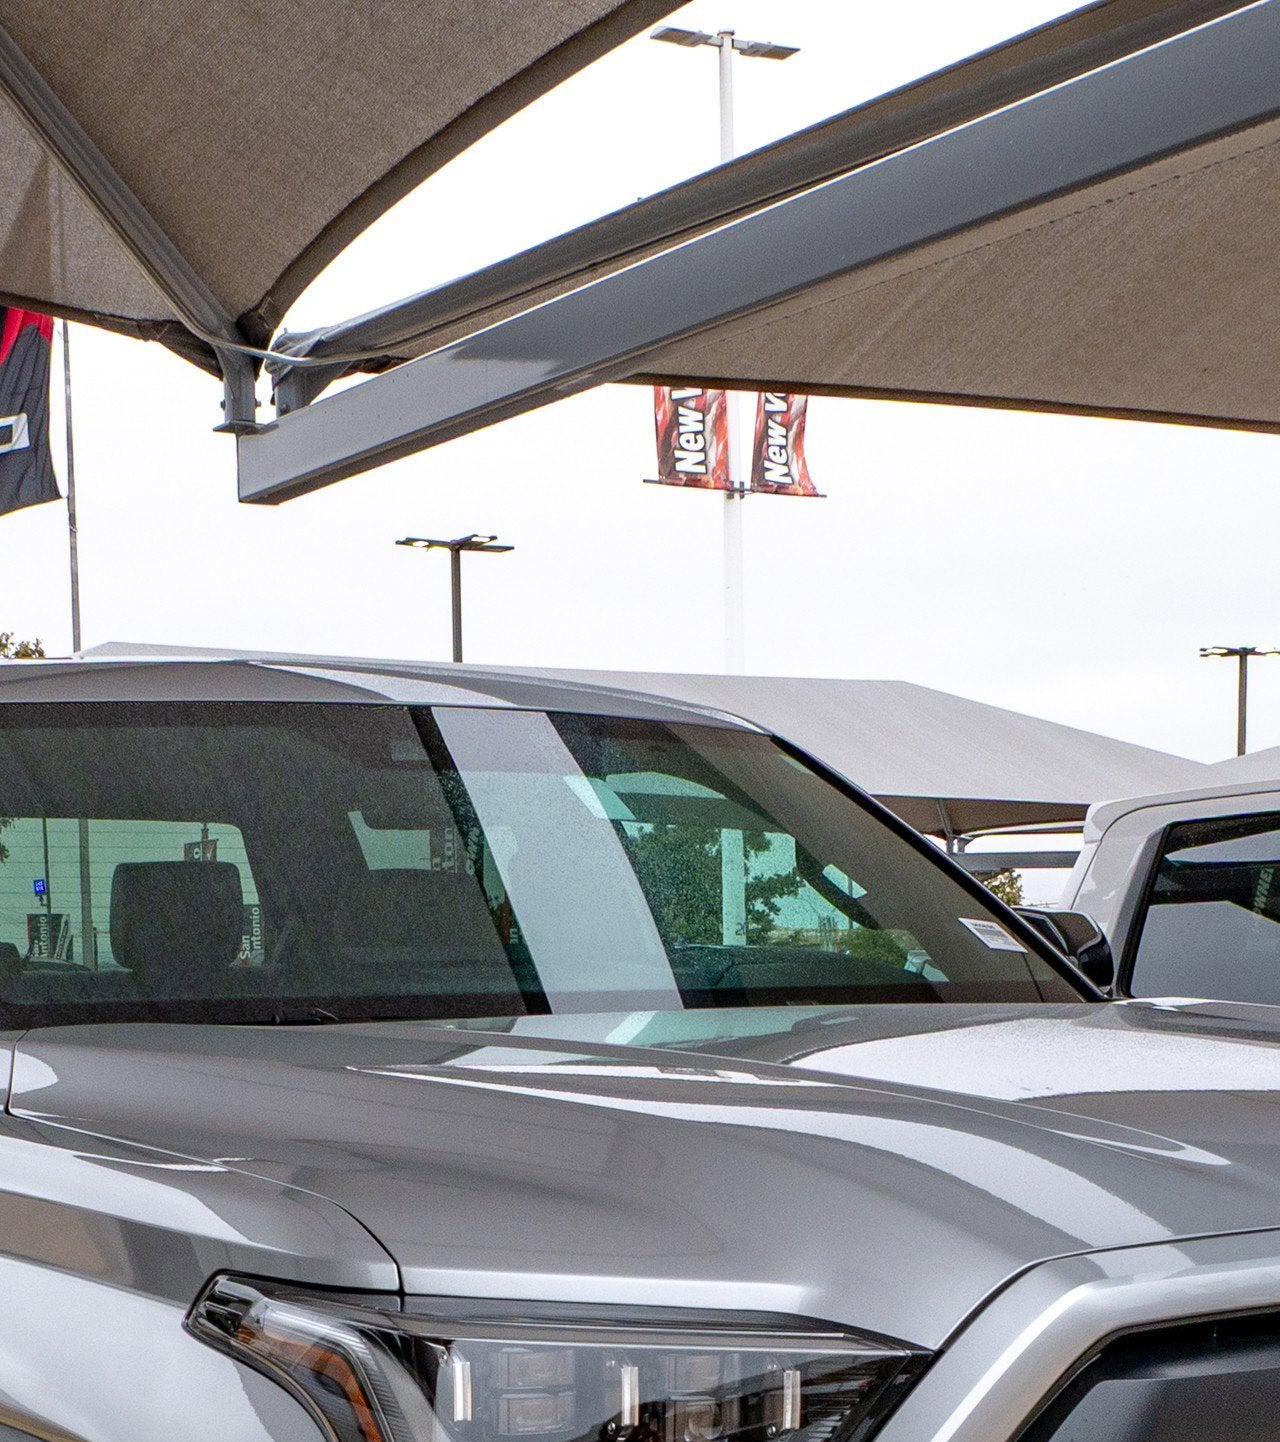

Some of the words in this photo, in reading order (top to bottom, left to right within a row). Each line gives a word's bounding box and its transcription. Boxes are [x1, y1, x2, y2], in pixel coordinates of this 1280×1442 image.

[672, 405, 708, 475] New
[763, 418, 794, 486] New
[251, 906, 261, 951] ntonio
